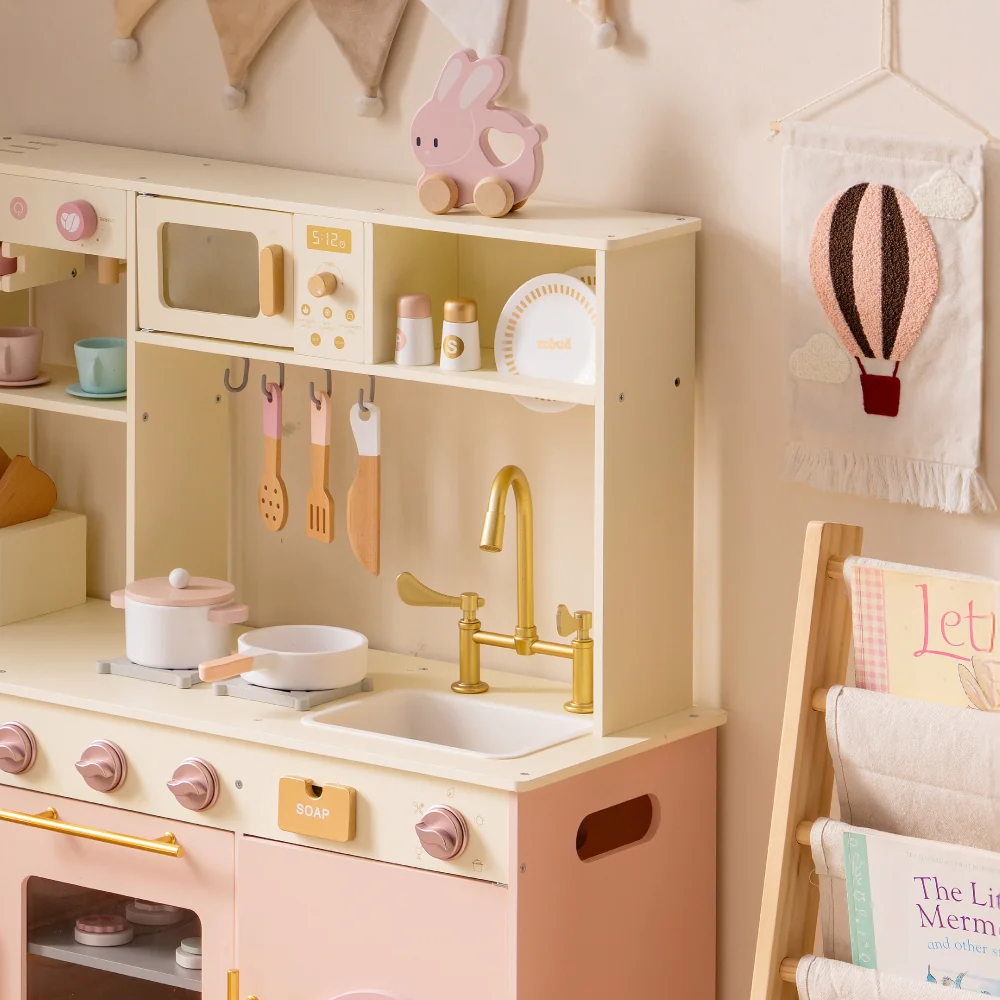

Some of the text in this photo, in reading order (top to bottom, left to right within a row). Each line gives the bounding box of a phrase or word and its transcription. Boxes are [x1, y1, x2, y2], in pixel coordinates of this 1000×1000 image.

[312, 230, 338, 247] 5:12
[446, 339, 458, 355] S
[296, 803, 330, 819] SOAP
[913, 876, 964, 902] The
[915, 903, 1000, 937] Merm
[927, 936, 951, 950] and
[954, 938, 988, 955] other
